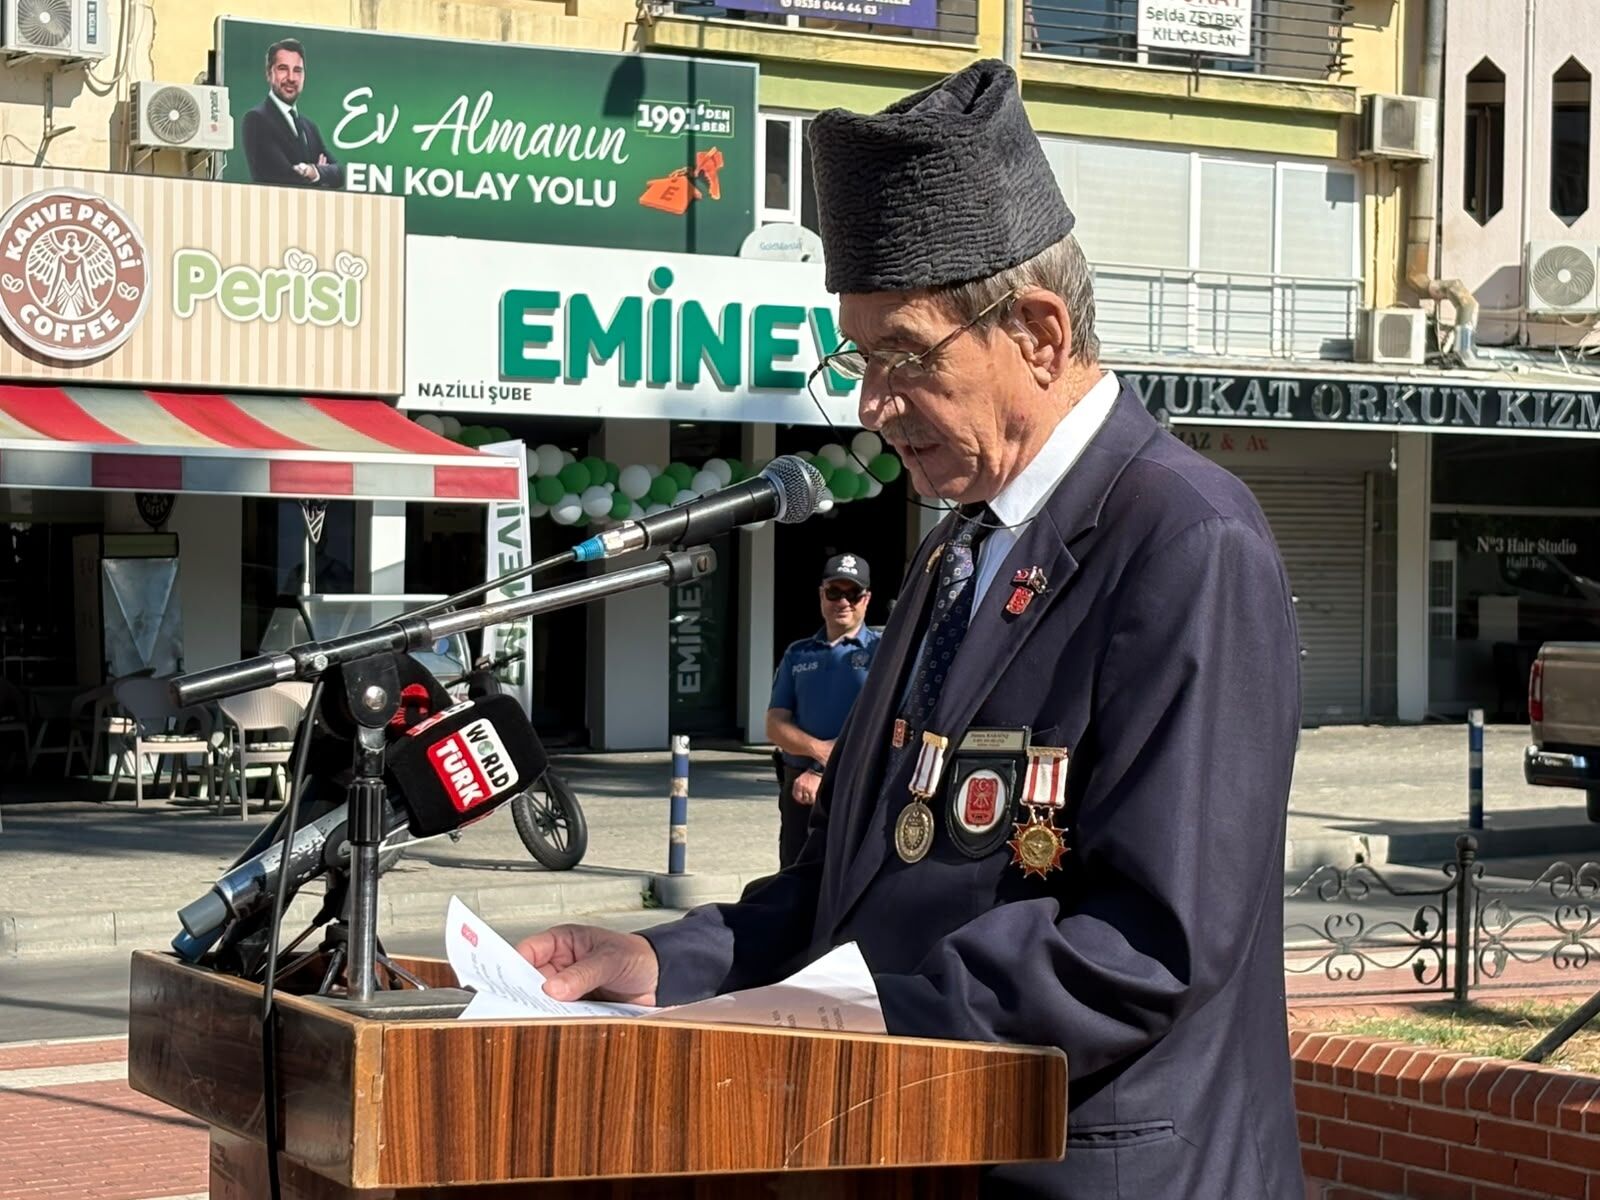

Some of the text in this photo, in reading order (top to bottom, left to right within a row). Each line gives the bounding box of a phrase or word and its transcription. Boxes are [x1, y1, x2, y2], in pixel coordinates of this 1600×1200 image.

[1146, 6, 1243, 28] Selda ZEYBEK
[332, 87, 629, 164] Ev Almanın
[701, 121, 730, 133] BERİ
[346, 162, 617, 208] EN KOLAY YOLU
[5, 203, 73, 262] KAHVE
[174, 248, 367, 327] Perisi
[20, 304, 120, 344] COFFEE
[418, 380, 532, 405] NAZİLLİ ŞUBE
[1311, 382, 1487, 426] ORKUN
[1507, 537, 1535, 553] Hair
[1537, 539, 1577, 555] Studio
[435, 738, 484, 807] TÜRK
